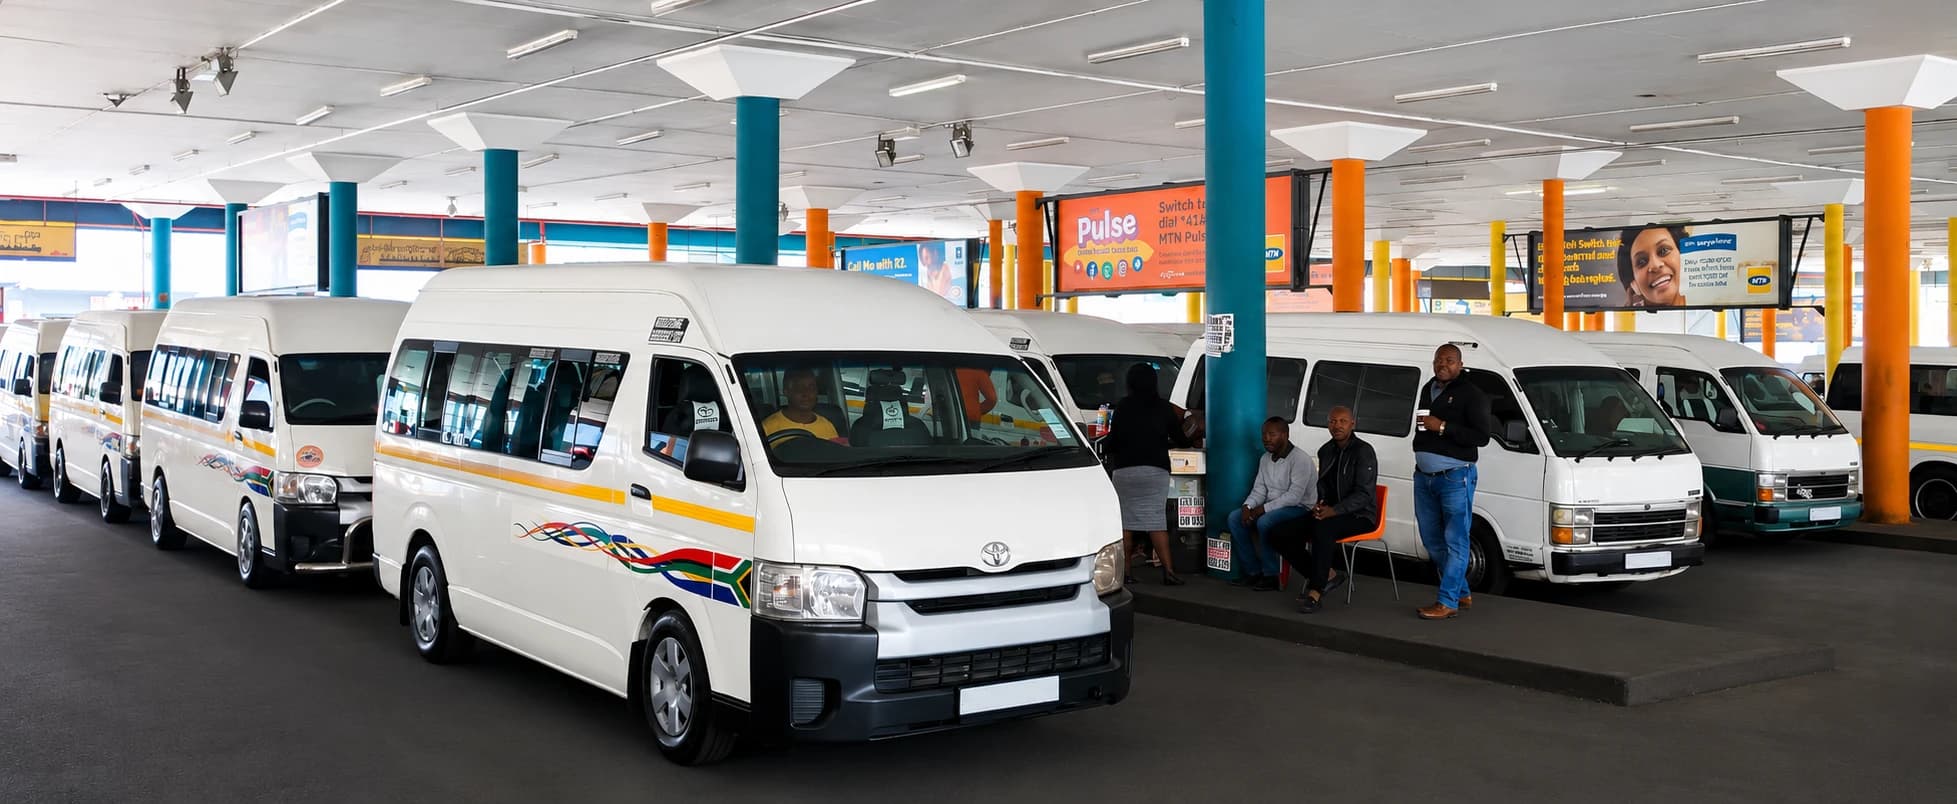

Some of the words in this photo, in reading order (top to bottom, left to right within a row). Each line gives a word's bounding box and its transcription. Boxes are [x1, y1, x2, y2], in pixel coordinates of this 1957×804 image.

[1158, 199, 1194, 214] Switch
[1077, 208, 1137, 244] Pulse
[1158, 215, 1177, 229] dial
[1158, 231, 1182, 245] MTN
